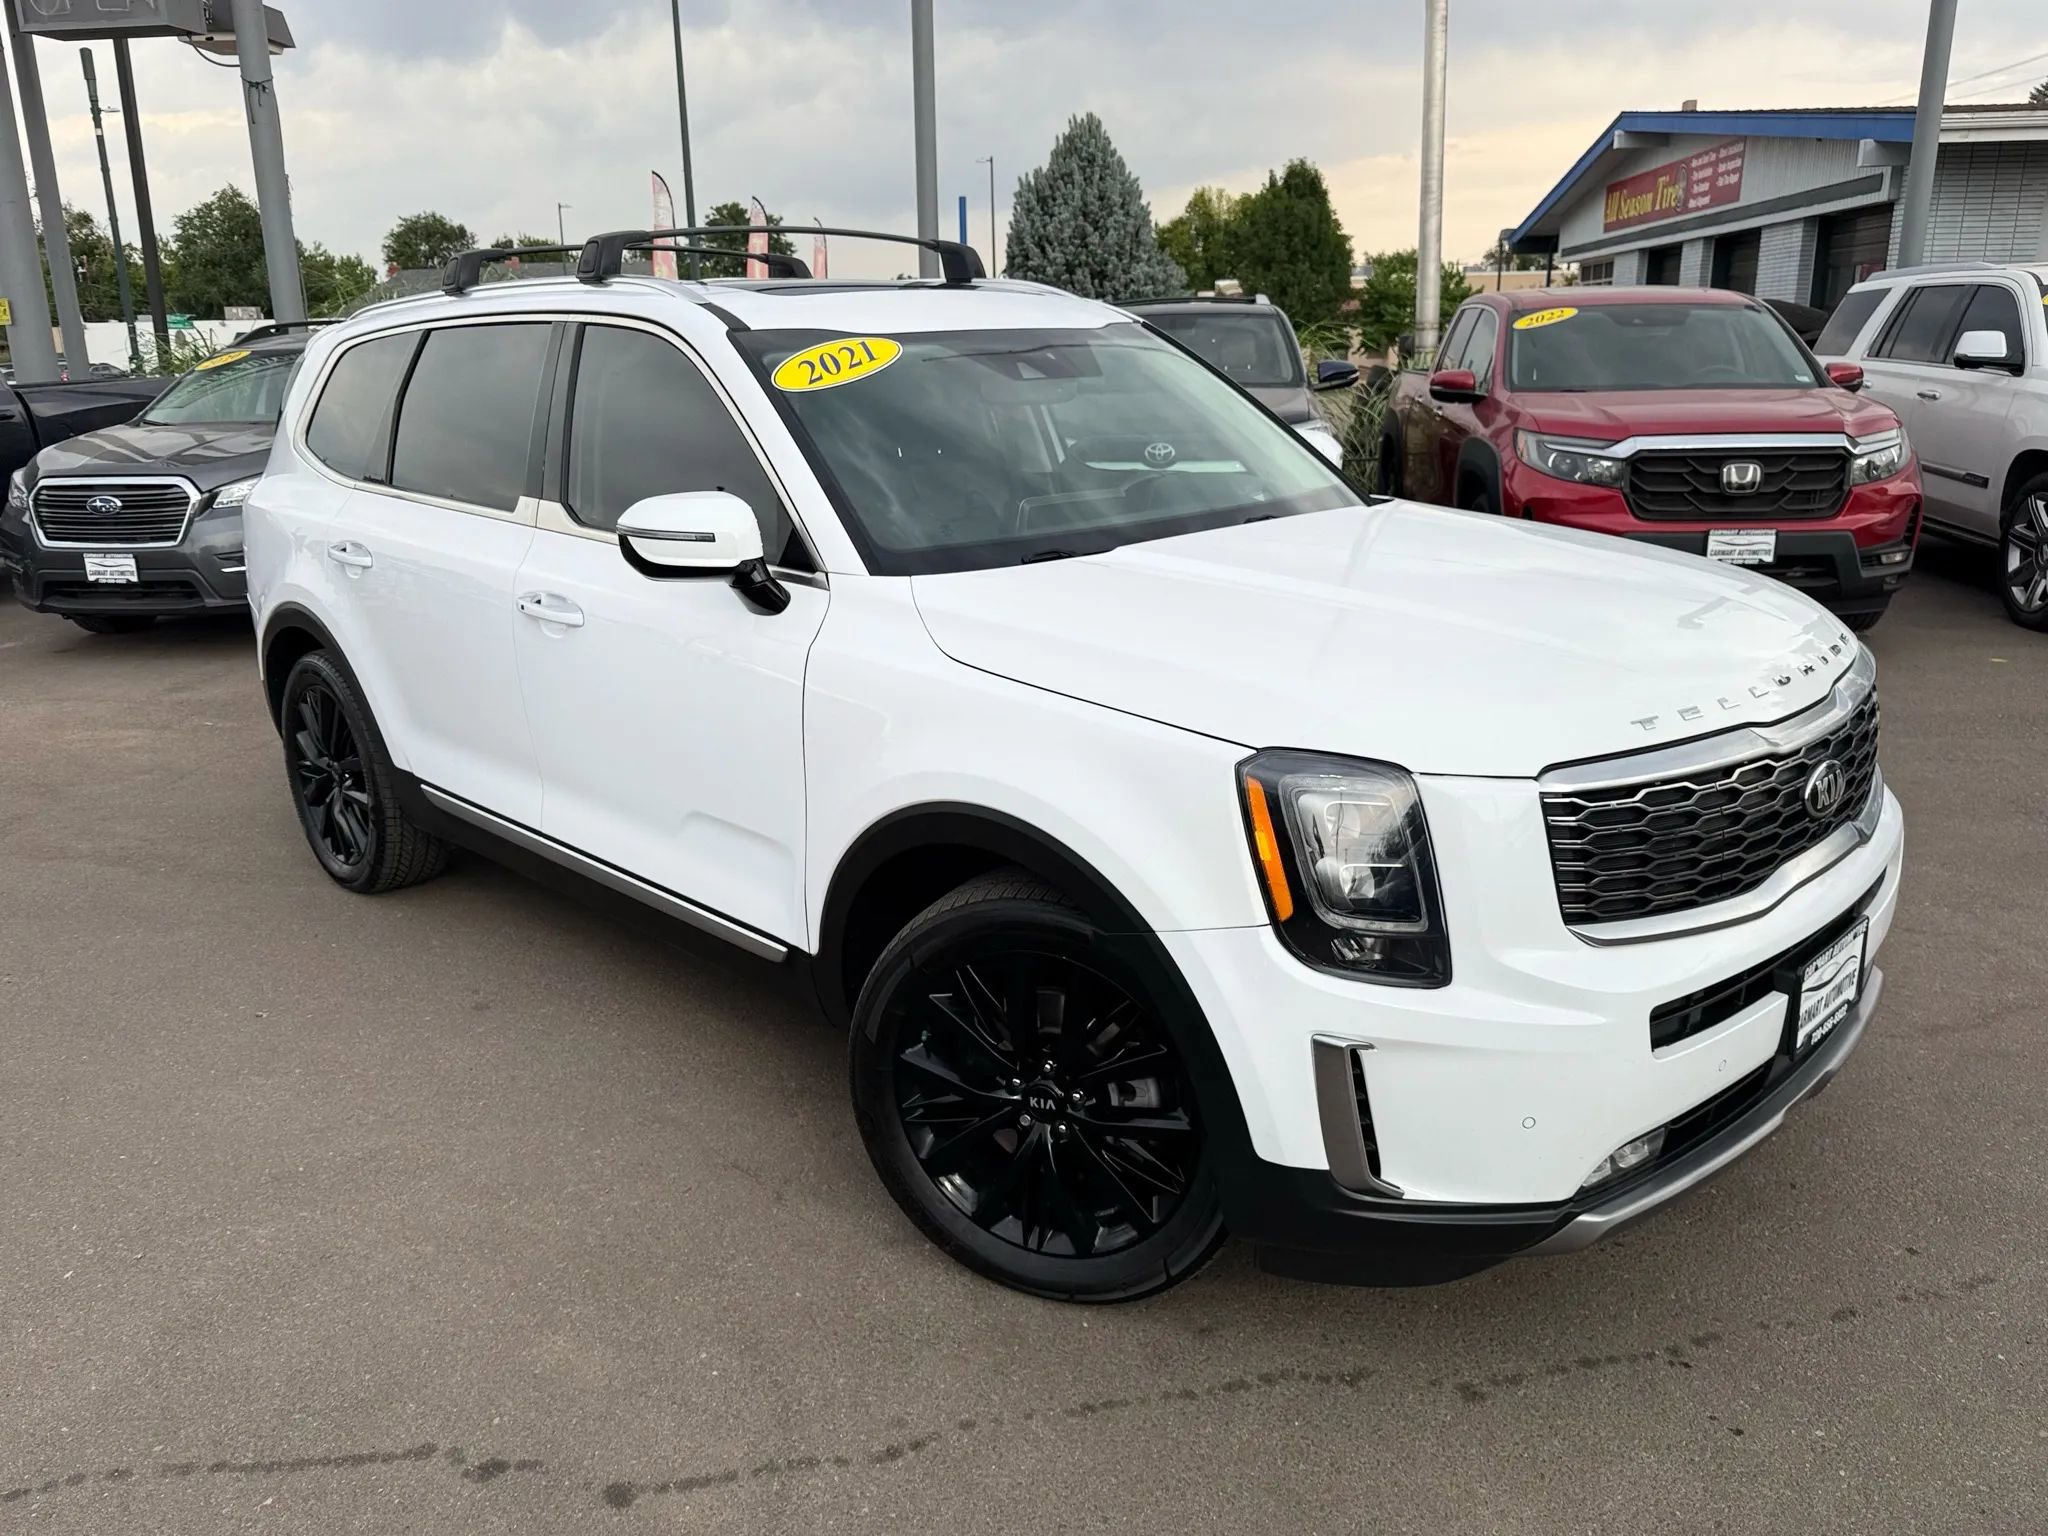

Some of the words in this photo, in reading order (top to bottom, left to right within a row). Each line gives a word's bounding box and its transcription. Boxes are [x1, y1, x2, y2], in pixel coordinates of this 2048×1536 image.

[1605, 192, 1619, 223] All
[1618, 189, 1653, 219] Season
[1526, 310, 1565, 326] 2022
[798, 340, 880, 385] 2021
[1710, 549, 1737, 557] CARMART
[1738, 549, 1772, 557] AUTOMOTIVE
[1630, 632, 1850, 731] TELLURIDE
[1815, 769, 1844, 809] KIA
[1799, 996, 1824, 1030] ARMART
[1823, 968, 1858, 1012] AUTOMOTIVE
[1029, 1096, 1057, 1110] KIA
